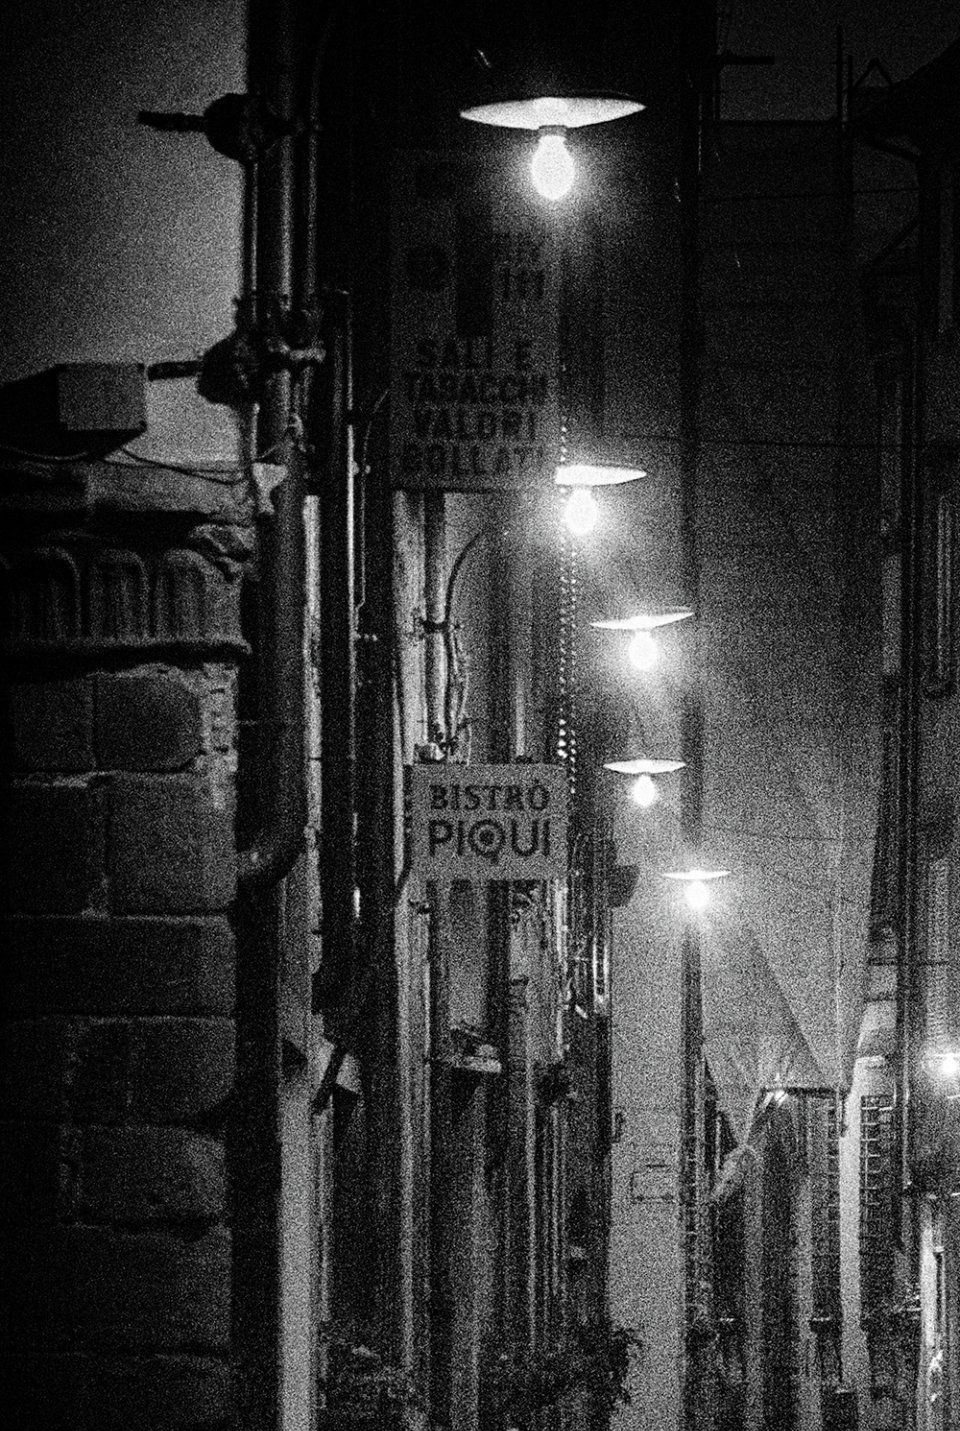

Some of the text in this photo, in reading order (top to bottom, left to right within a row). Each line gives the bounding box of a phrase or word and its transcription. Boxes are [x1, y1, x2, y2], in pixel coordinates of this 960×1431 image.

[416, 338, 532, 370] SALI E
[402, 371, 547, 405] TABACCHI
[413, 408, 536, 441] VALORI
[428, 819, 551, 865] PIQUI
